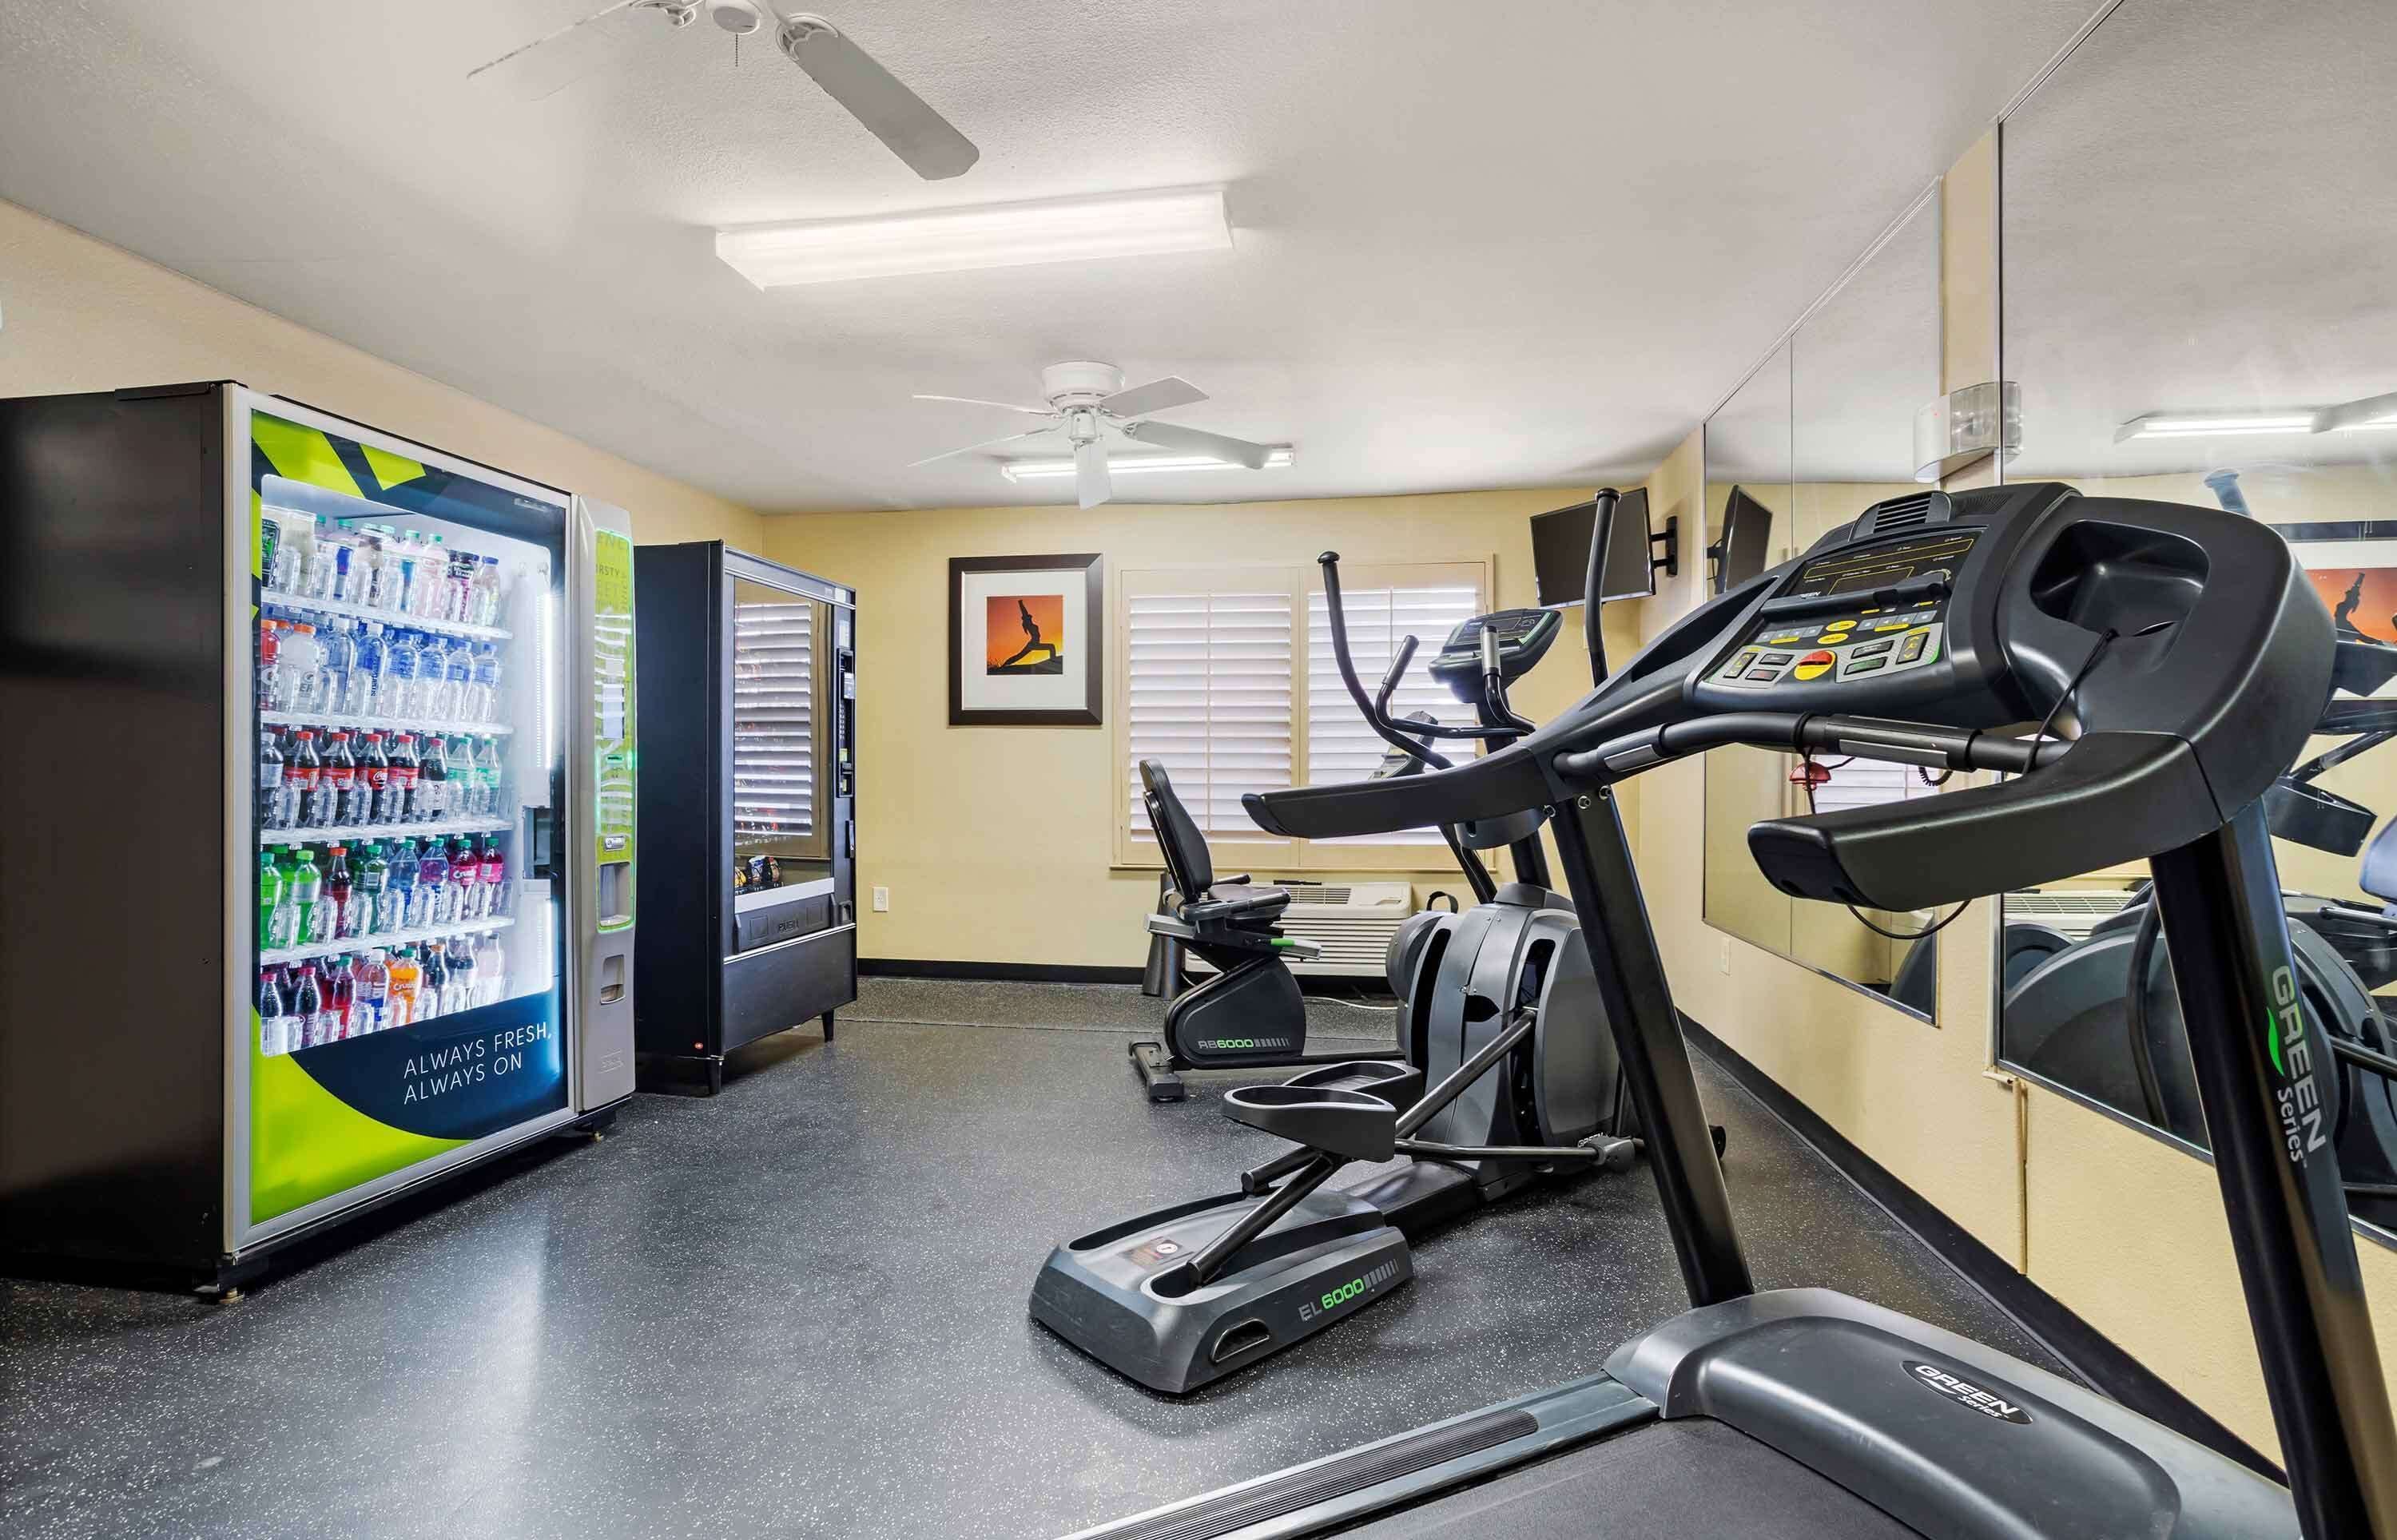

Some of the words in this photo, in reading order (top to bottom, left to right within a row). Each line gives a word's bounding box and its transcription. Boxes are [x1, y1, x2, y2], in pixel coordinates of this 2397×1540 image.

[403, 1039, 485, 1079] ALWAYS
[494, 1022, 552, 1052] FRESH,
[1198, 1039, 1254, 1049] RB6000
[2272, 965, 2326, 1153] GREEN
[403, 1063, 485, 1105] ALWAYS
[494, 1051, 522, 1075] ON
[2277, 1086, 2304, 1163] Series
[1915, 1365, 2019, 1414] GREEN
[1958, 1395, 2002, 1418] Series
